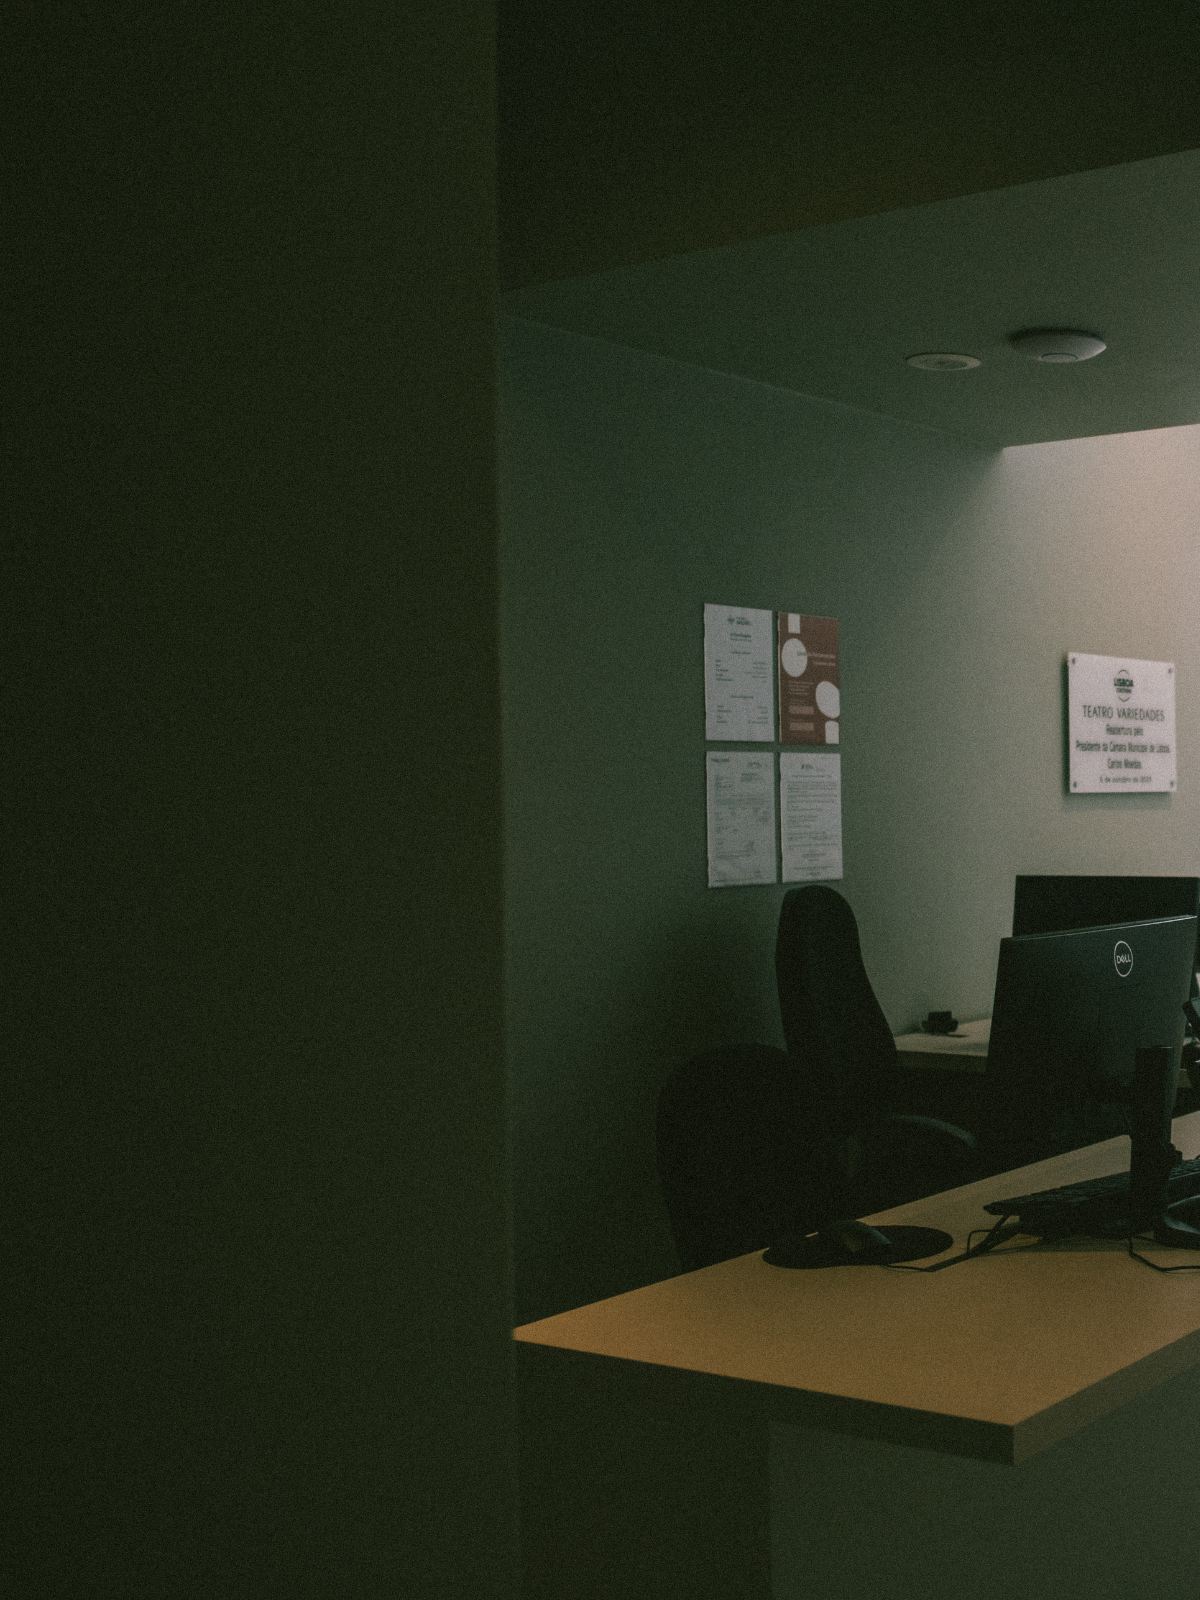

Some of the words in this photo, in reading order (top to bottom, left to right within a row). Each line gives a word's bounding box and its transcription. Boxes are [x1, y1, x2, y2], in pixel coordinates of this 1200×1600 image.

[1083, 705, 1113, 719] TEATRO
[1117, 707, 1165, 721] VARIEDADES
[1116, 954, 1131, 964] DELL
